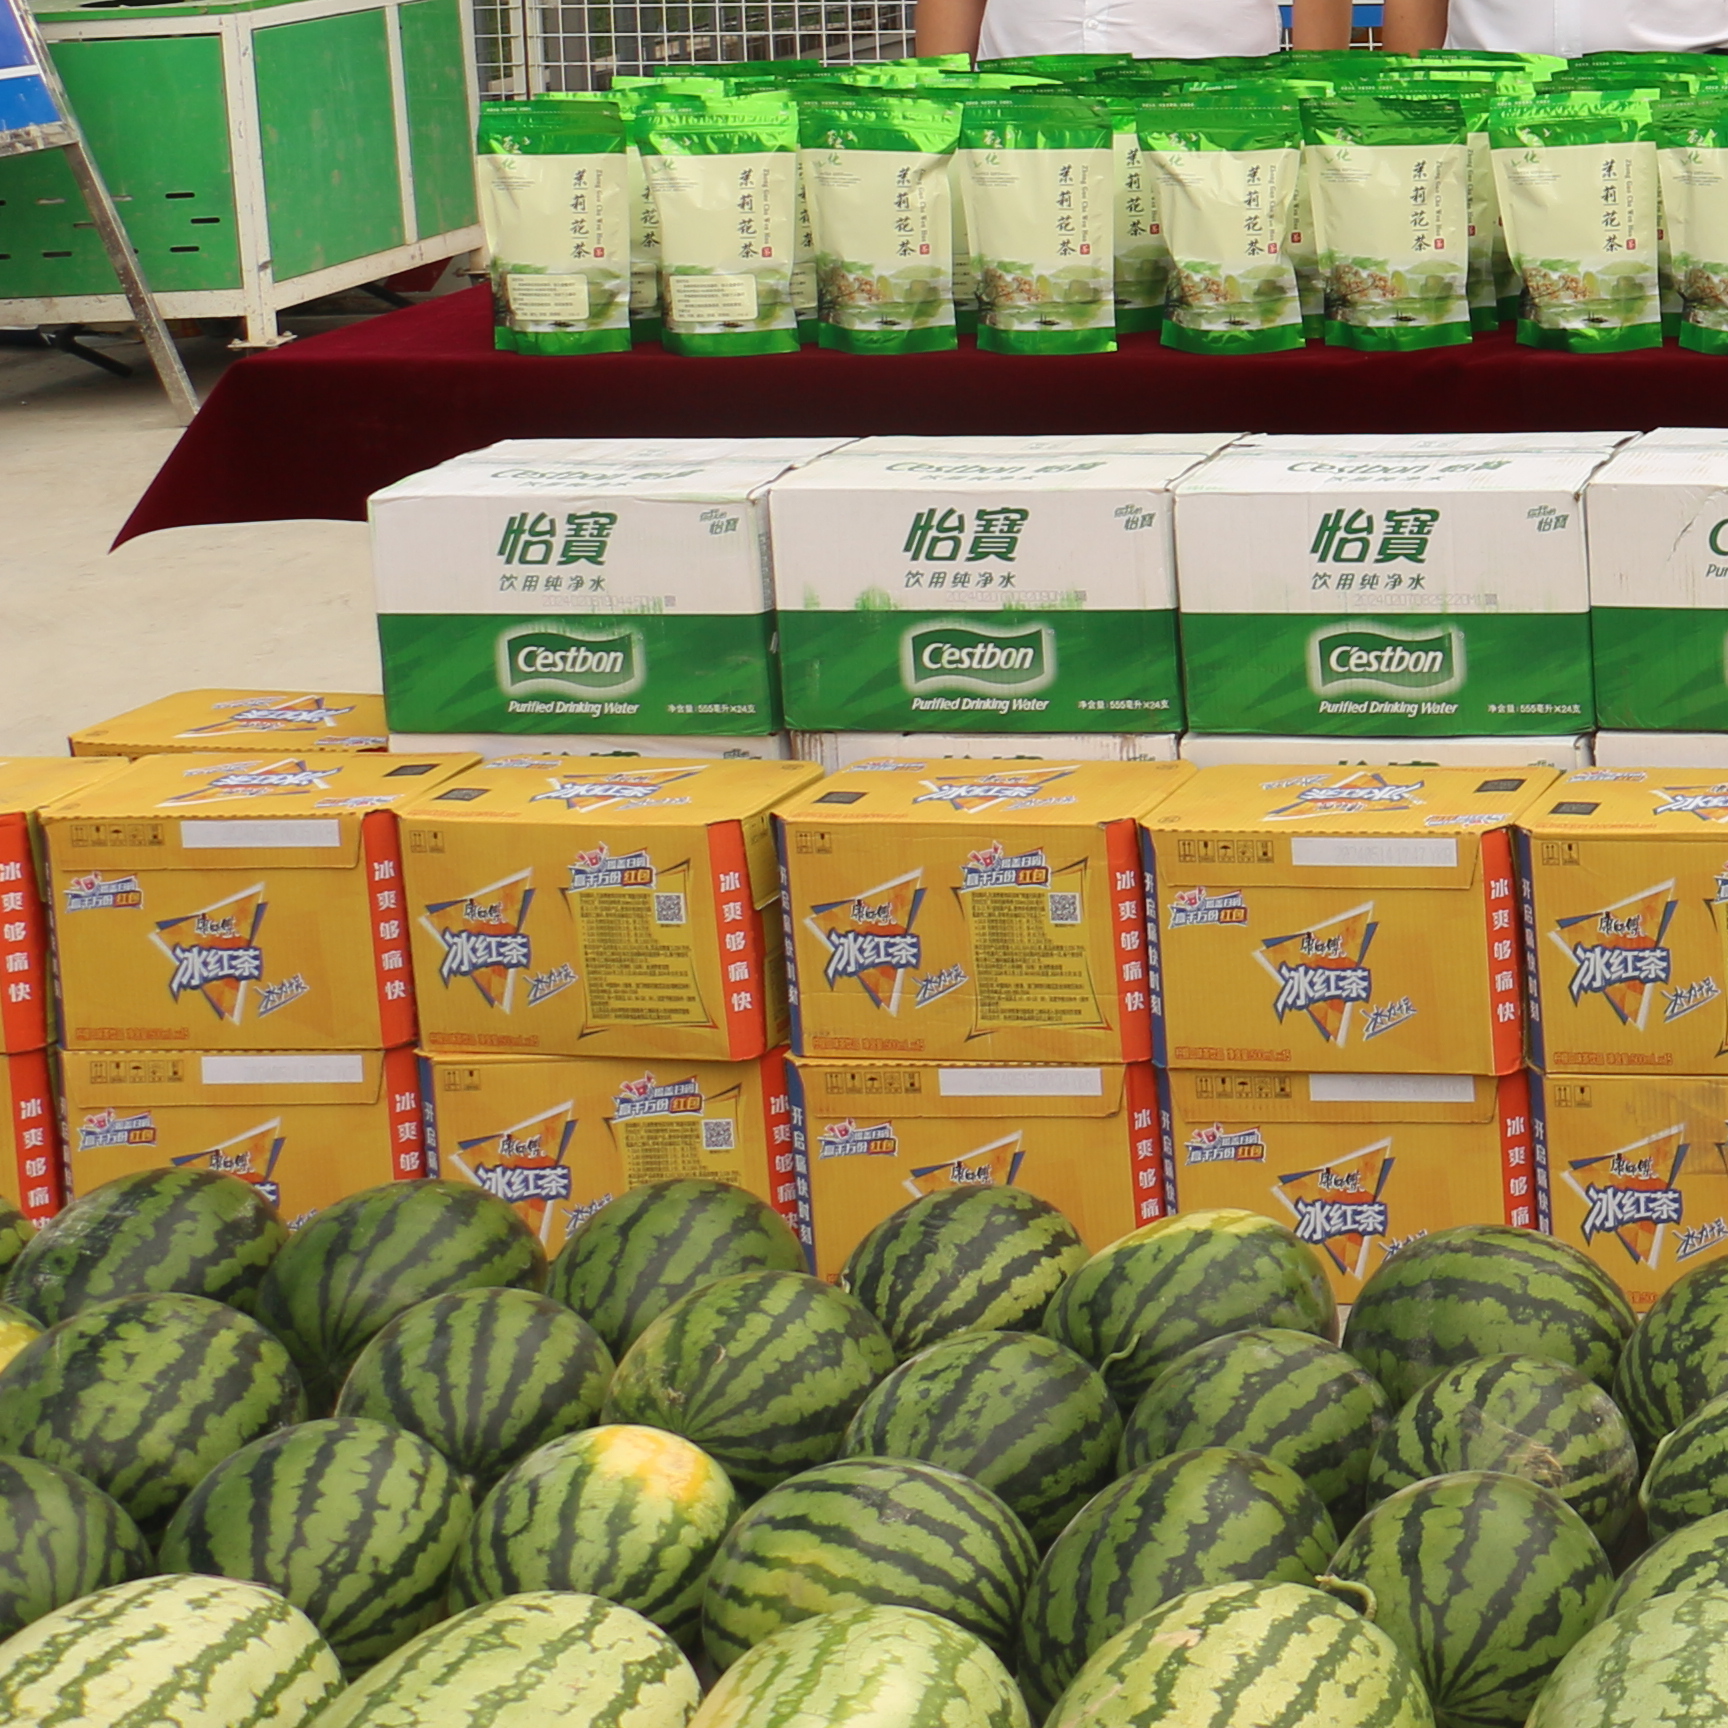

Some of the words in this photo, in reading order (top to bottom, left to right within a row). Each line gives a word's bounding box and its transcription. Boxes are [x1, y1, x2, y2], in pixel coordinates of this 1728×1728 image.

[569, 168, 590, 260] 茉莉花茶
[737, 168, 758, 260] 茉莉花茶
[1056, 165, 1076, 257] 茉莉花茶
[1244, 164, 1264, 258] 茉莉花茶
[1409, 159, 1431, 253] 茉莉花茶
[496, 511, 617, 566] 怡寶
[903, 506, 1029, 563] 怡寶
[1309, 507, 1440, 565] 怡寶
[499, 572, 607, 593] 饮用纯净水
[904, 570, 1016, 591] 饮用纯净水
[1310, 571, 1426, 592] 饮用纯净水
[373, 859, 406, 1002] 冰爽够痛快
[828, 930, 921, 972] 冰红茶
[1114, 869, 1146, 1013] 冰爽够痛快
[173, 948, 262, 990] 冰红茶
[1575, 946, 1668, 990] 冰红茶
